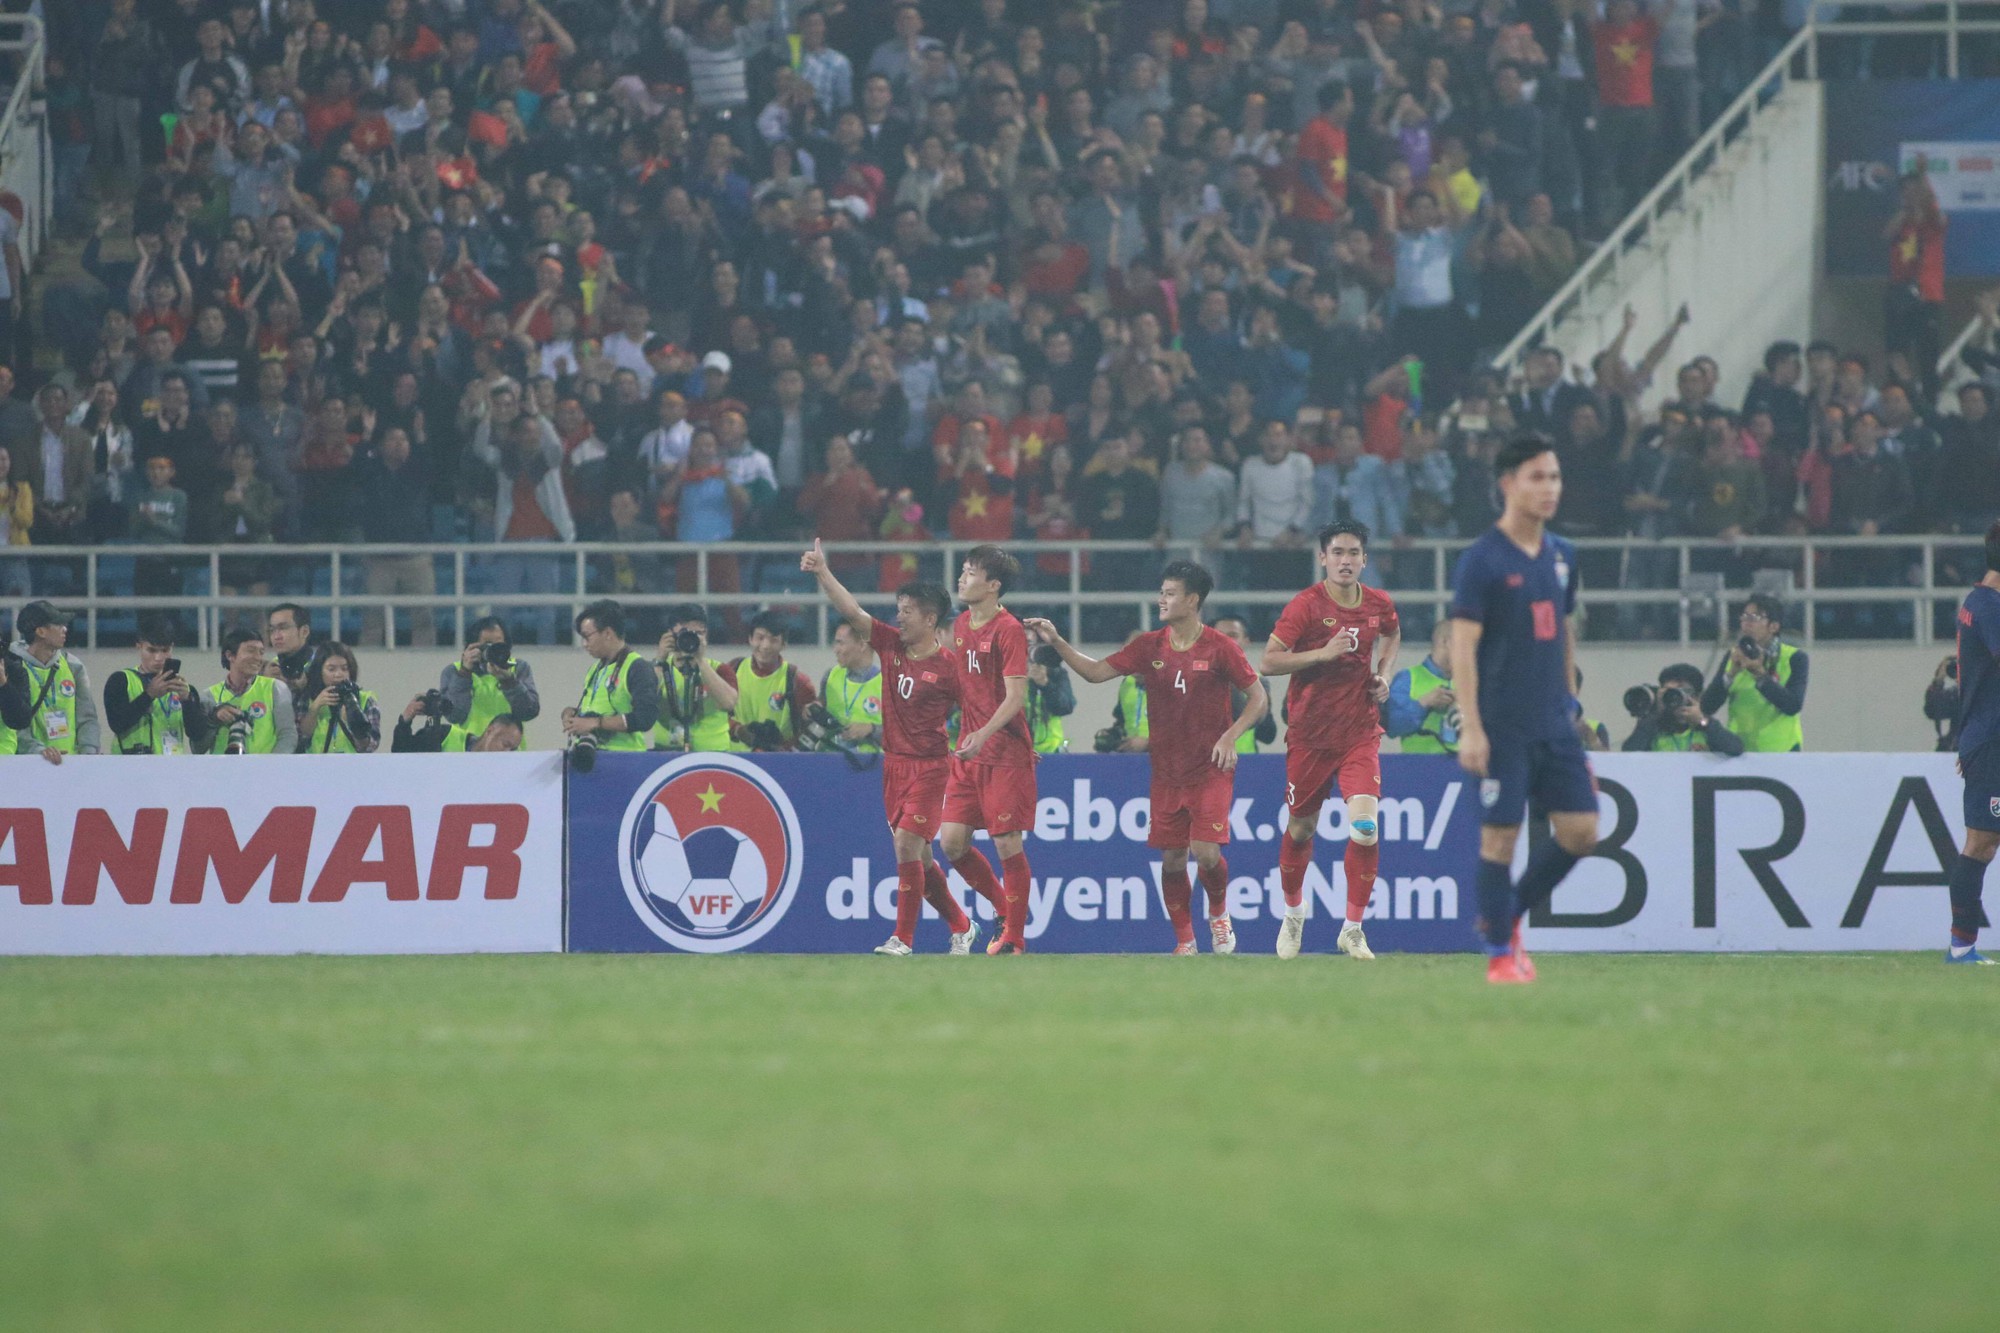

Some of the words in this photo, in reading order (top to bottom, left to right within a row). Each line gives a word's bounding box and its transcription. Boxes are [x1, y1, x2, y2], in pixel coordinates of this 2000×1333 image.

[967, 649, 981, 674] 14
[898, 673, 914, 699] 10
[1175, 670, 1186, 694] 4
[1528, 776, 1991, 928] BRA
[689, 895, 733, 915] VFF
